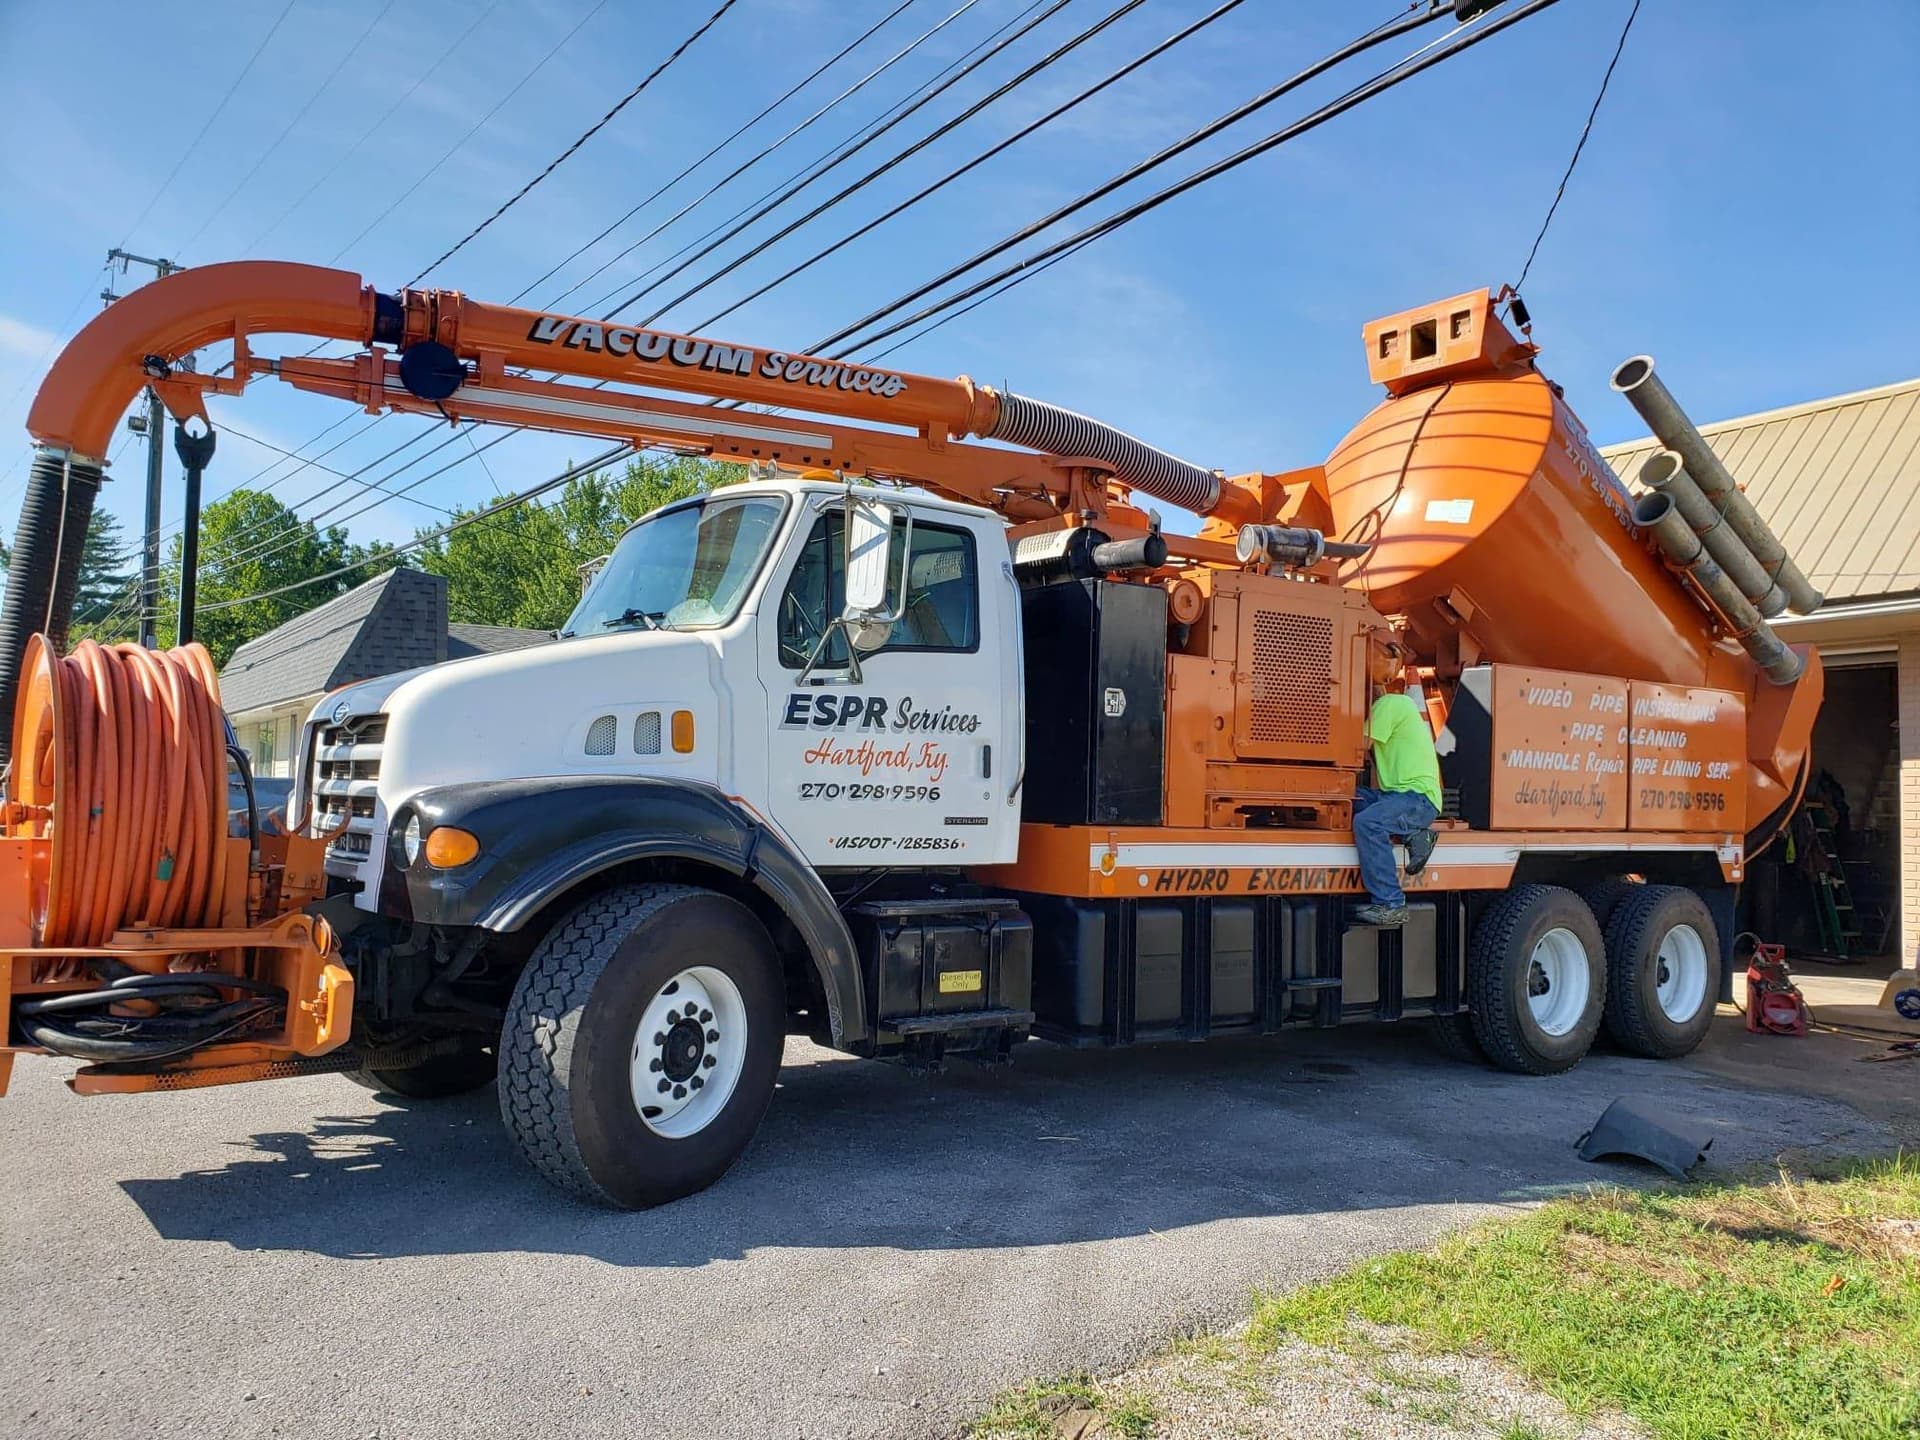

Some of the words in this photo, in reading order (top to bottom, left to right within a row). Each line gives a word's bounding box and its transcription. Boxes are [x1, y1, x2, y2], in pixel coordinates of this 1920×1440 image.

[527, 316, 755, 376] VACUUM
[759, 351, 908, 398] Services
[780, 693, 888, 731] ESPR
[893, 696, 982, 733] Services
[1527, 687, 1573, 708] VIDEO
[1589, 694, 1624, 713] PIPE
[1633, 699, 1718, 722] INSPECTIONS
[1570, 722, 1605, 741] PIPE
[1617, 726, 1687, 748] CLEANING
[1507, 749, 1580, 770] MANHOLE
[1585, 751, 1624, 782] Repair
[1632, 757, 1657, 776] PIPE
[1662, 759, 1701, 777] LINING
[1706, 762, 1731, 780] SER.
[1154, 868, 1229, 891] HYDRO
[1247, 868, 1364, 890] EXCAVATIN
